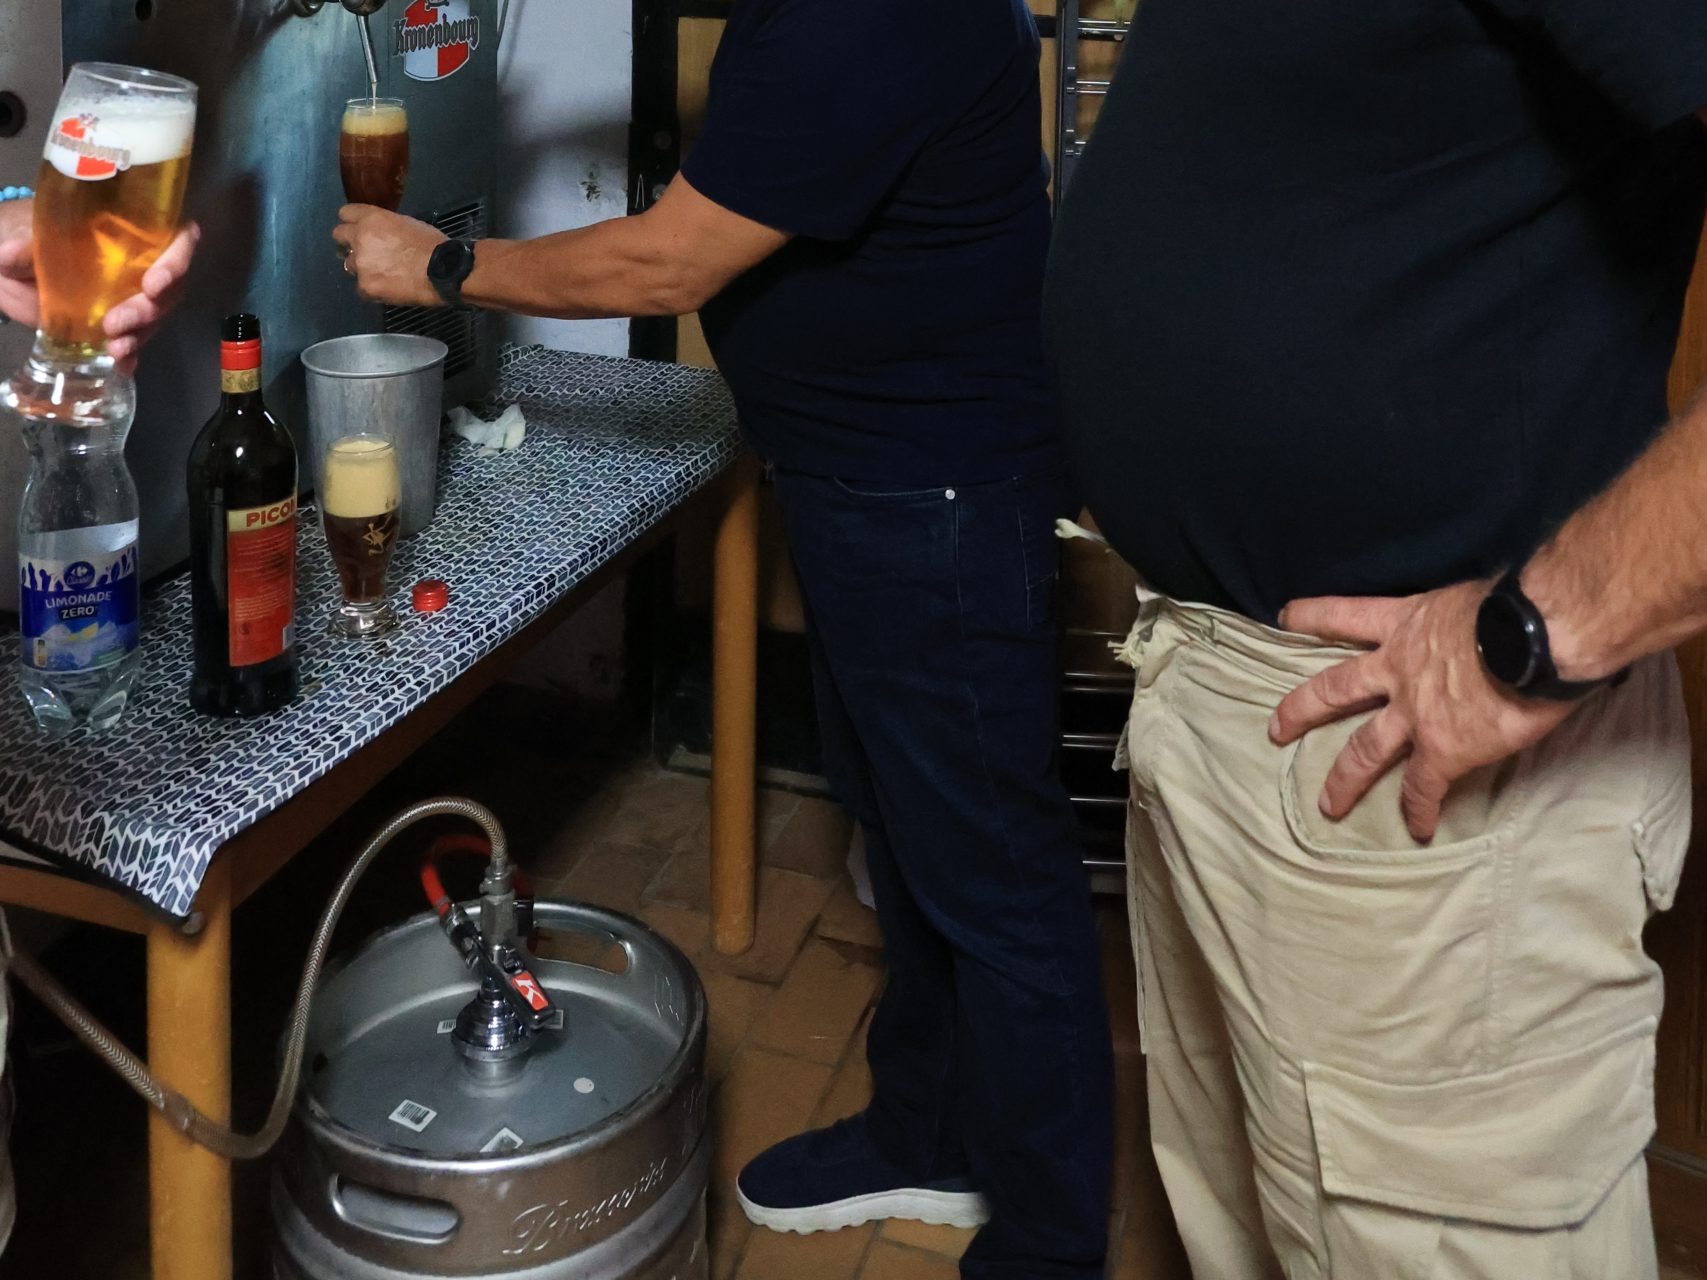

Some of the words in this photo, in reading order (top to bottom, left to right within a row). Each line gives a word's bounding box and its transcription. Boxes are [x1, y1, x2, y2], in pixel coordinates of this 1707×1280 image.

[392, 13, 479, 56] Kronenbourg
[45, 590, 112, 608] LIMONADE
[61, 606, 95, 619] ZERO
